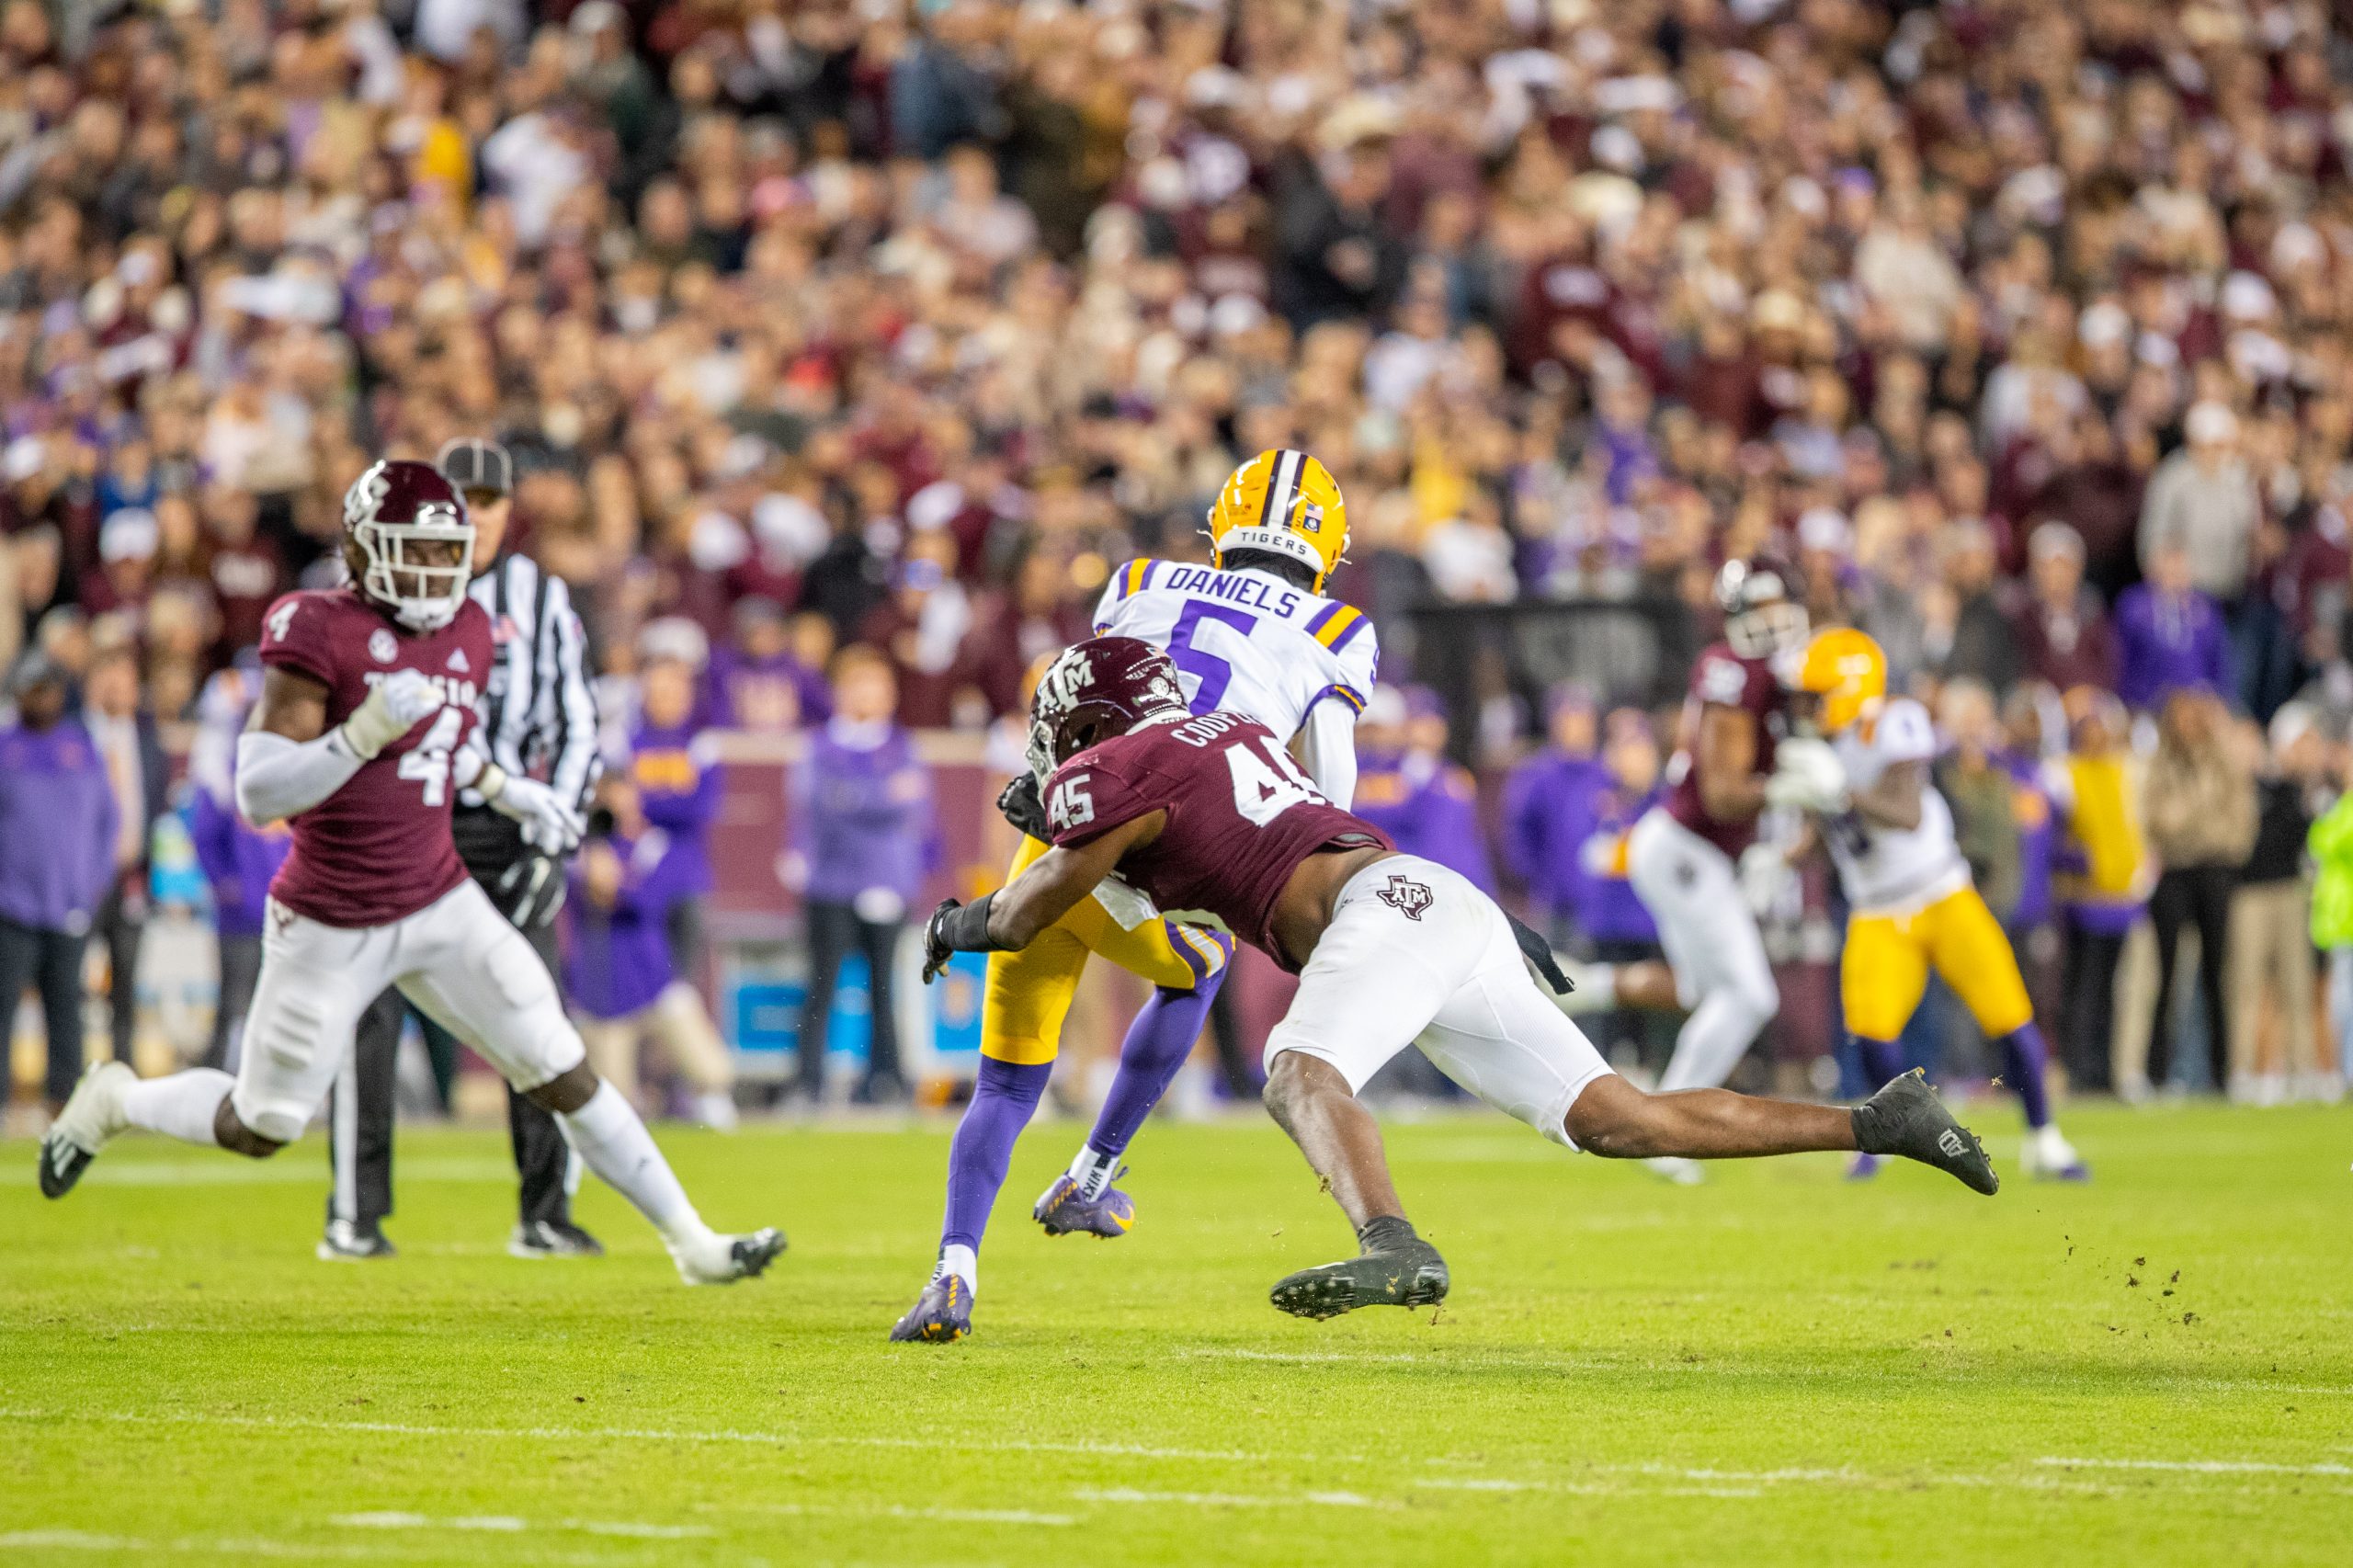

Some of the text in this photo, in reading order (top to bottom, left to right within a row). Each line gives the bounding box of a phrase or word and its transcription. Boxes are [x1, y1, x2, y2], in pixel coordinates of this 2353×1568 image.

[1241, 531, 1307, 556] TIGERS
[1165, 567, 1301, 619] DANIELS
[269, 600, 300, 642] 4
[1165, 598, 1259, 717] 5
[1170, 710, 1263, 748] COOP
[397, 706, 463, 807] 4
[1051, 773, 1096, 830] 45
